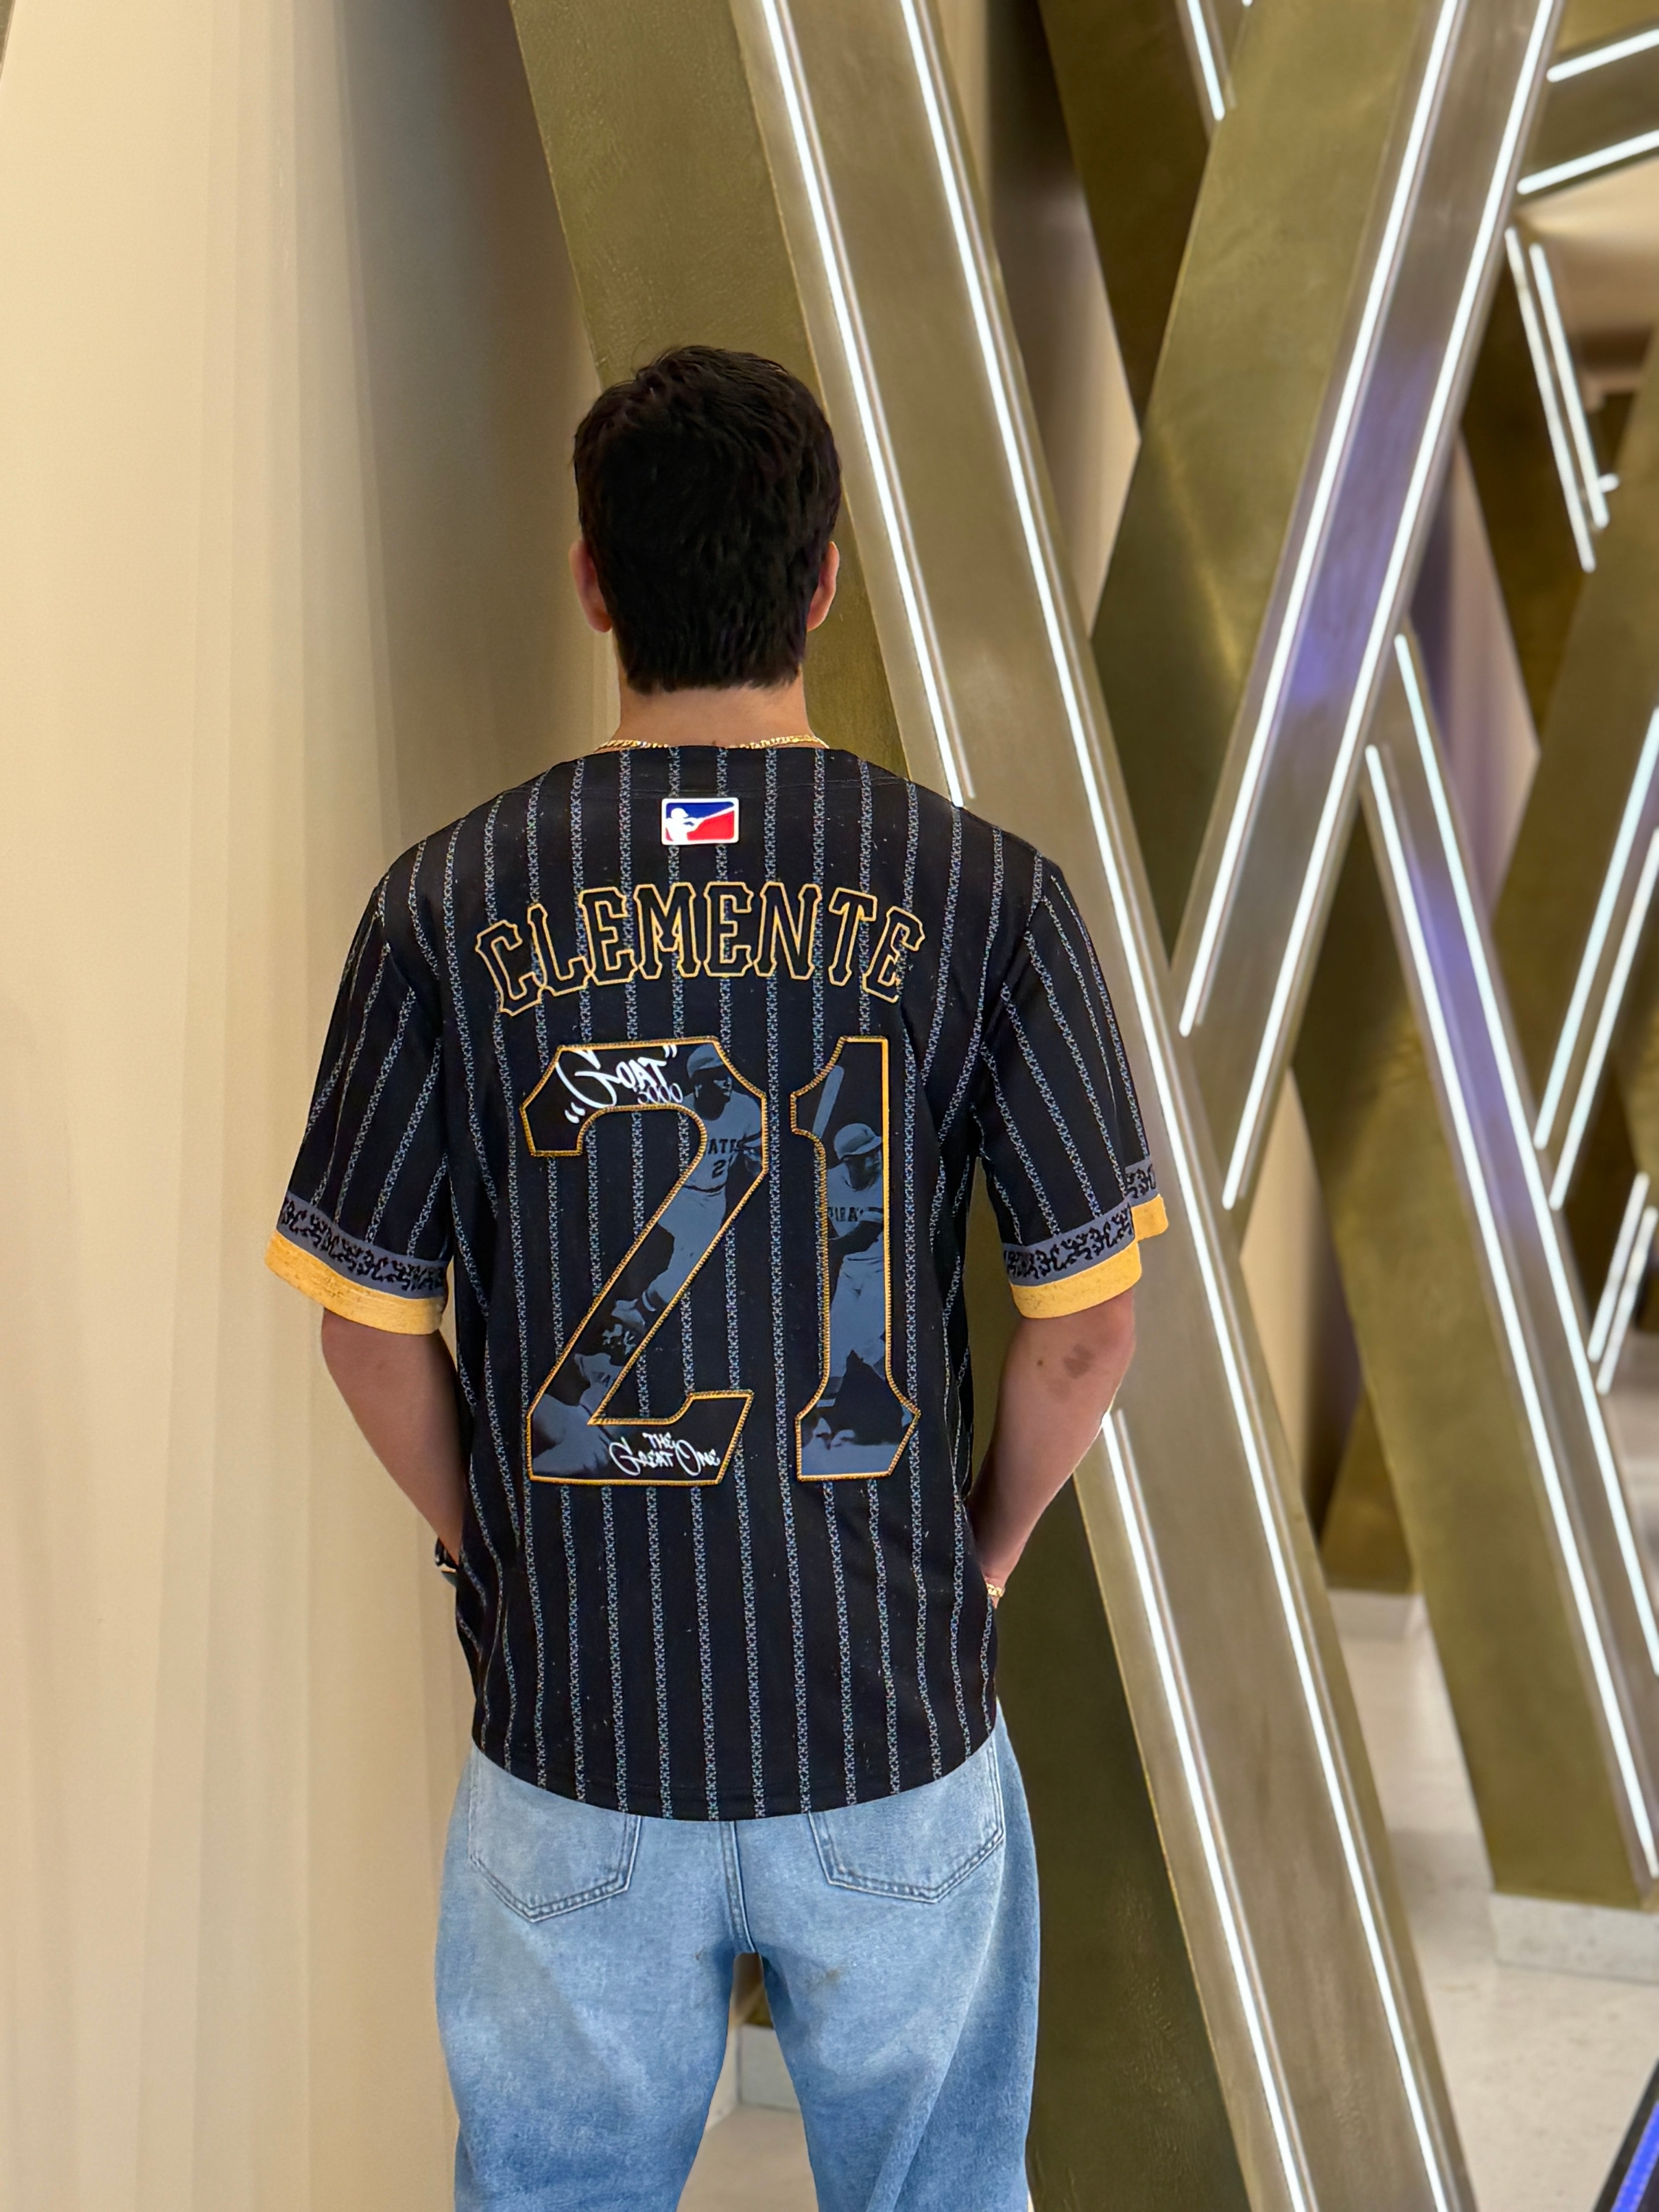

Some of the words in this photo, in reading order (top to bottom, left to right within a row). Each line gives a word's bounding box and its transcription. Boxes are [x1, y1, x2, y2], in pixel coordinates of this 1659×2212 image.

[475, 881, 925, 1016] CLEMENTE
[520, 1035, 922, 1486] 21
[642, 1432, 675, 1449] THE
